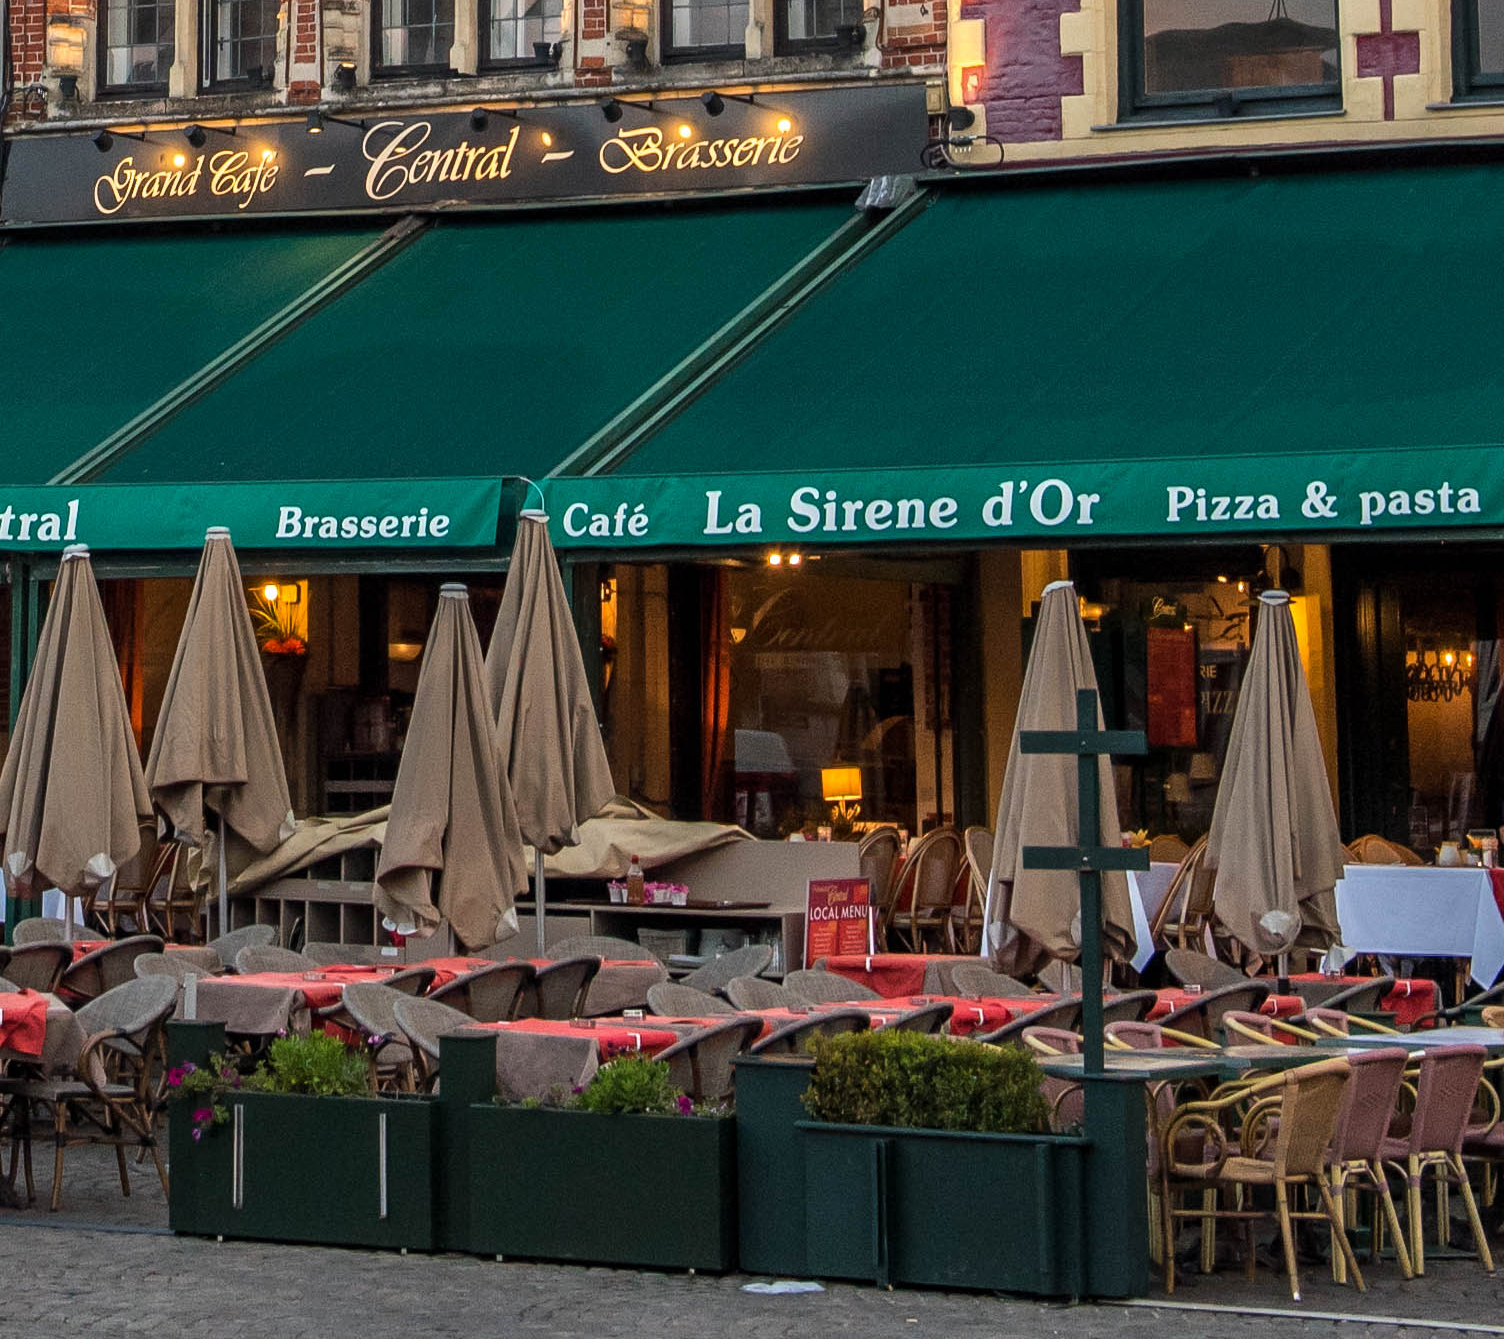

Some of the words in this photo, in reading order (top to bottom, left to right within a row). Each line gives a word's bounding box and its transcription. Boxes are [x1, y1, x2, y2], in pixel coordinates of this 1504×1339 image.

[94, 154, 204, 216] Grand
[362, 119, 521, 200] Central
[599, 125, 805, 175] Brasserie
[275, 506, 450, 539] Brasserie
[562, 502, 649, 537] Café
[703, 490, 763, 535] La
[787, 486, 958, 533] Sirene
[981, 478, 1101, 527] d'Or
[1166, 486, 1281, 522] Pizza
[1301, 480, 1338, 519] &
[1358, 481, 1481, 525] pasta
[809, 905, 840, 921] LOCAL
[841, 905, 868, 919] MENU
